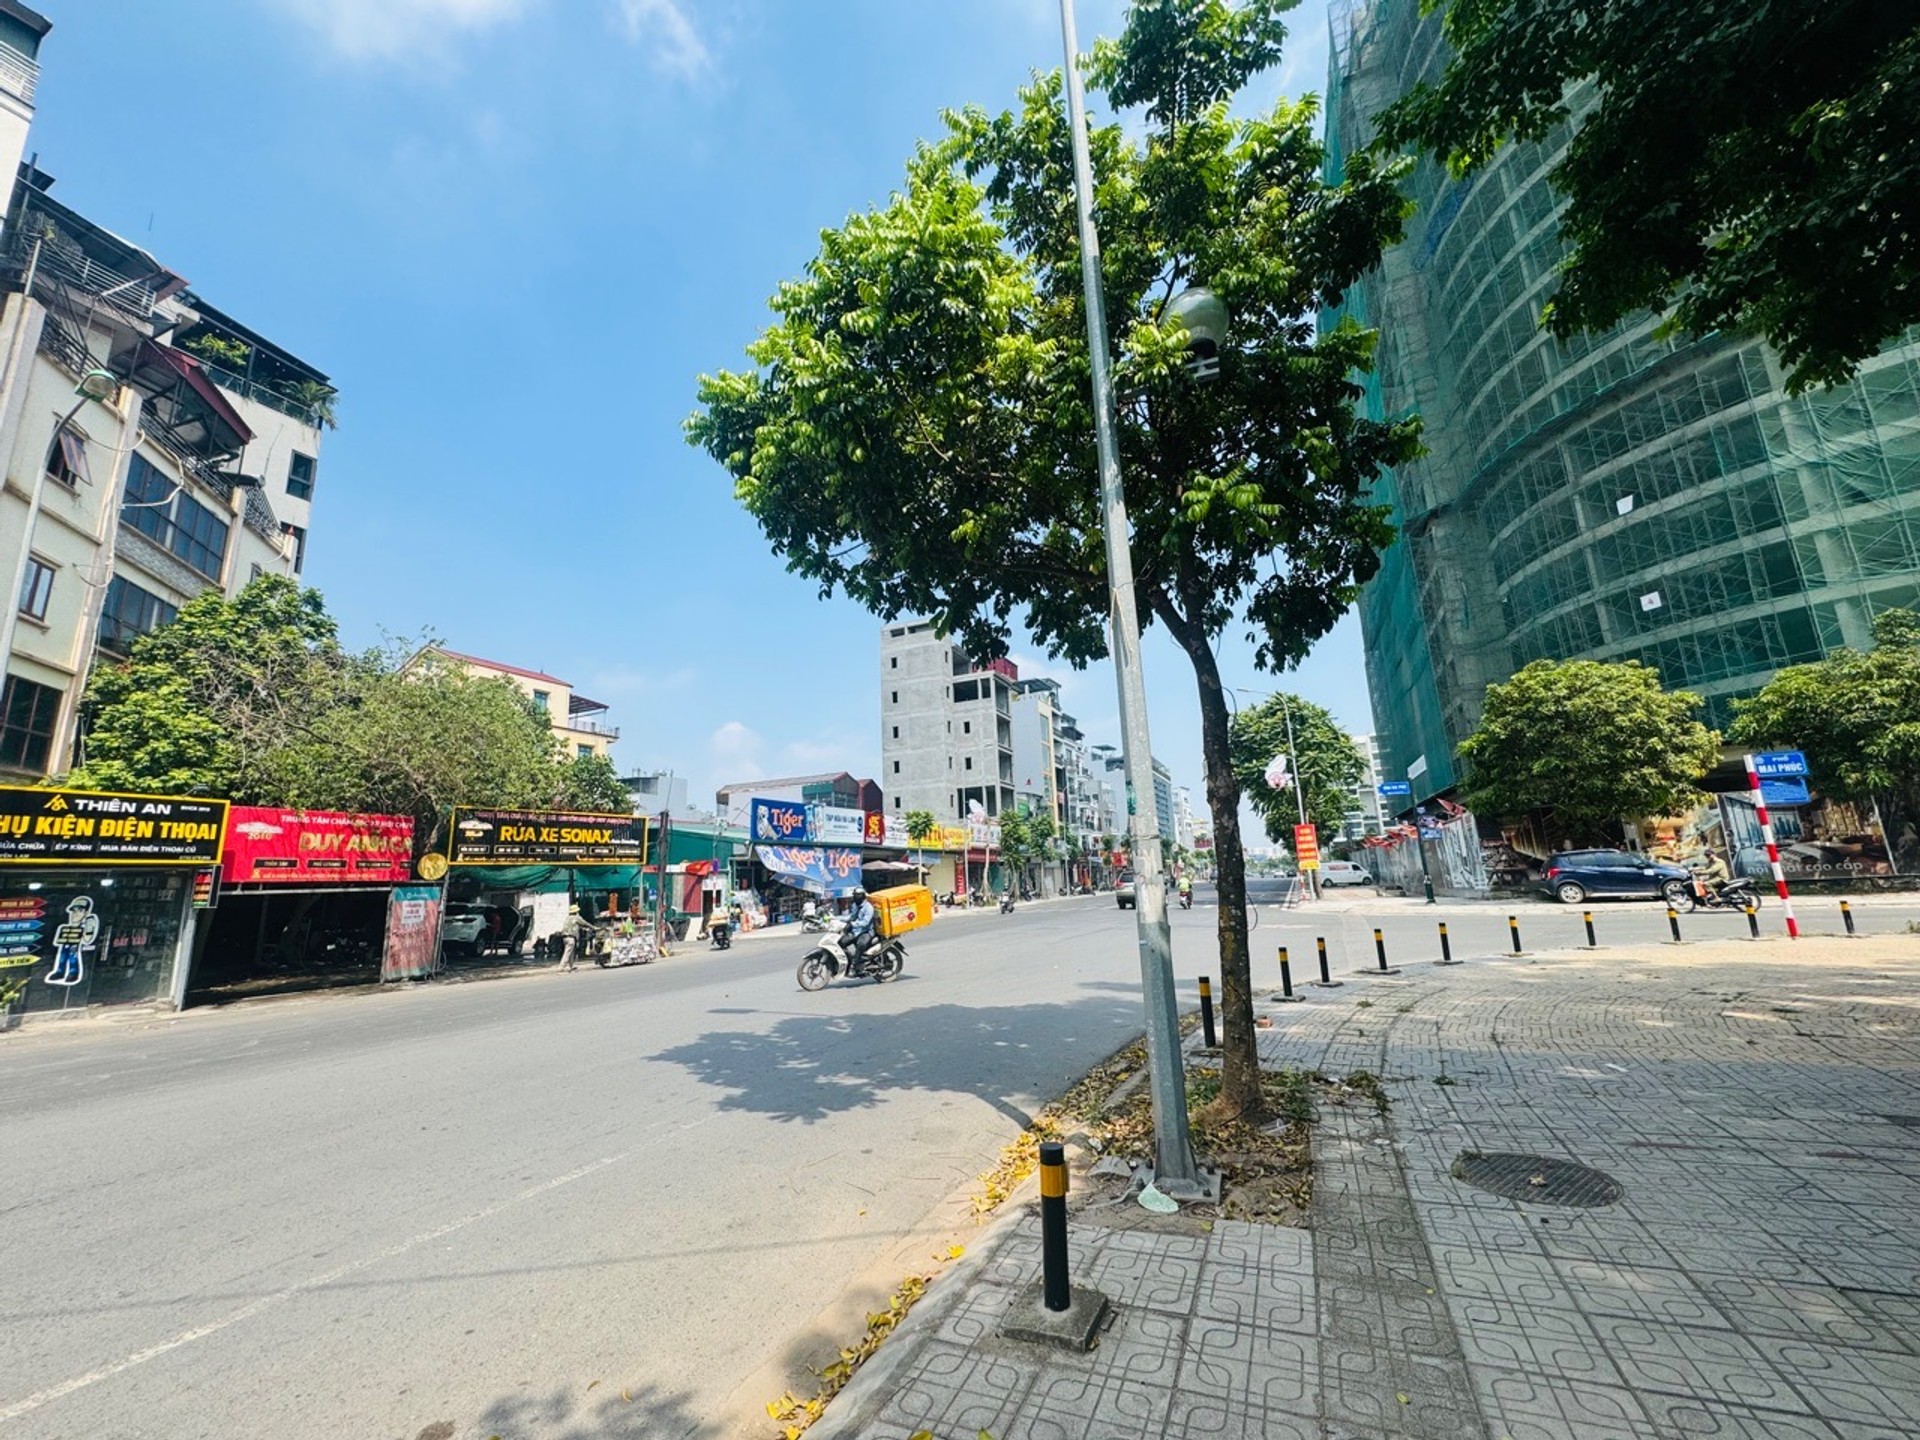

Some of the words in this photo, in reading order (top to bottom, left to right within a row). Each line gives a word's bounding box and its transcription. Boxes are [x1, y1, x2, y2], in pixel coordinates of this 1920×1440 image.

[1757, 764, 1777, 774] MAI
[1777, 761, 1803, 773] PHÚC
[74, 798, 137, 813] THIÊN
[141, 803, 172, 815] AN
[34, 813, 95, 839] KIỆN
[99, 816, 154, 841] ĐIỆN
[770, 807, 804, 835] Tiger
[299, 832, 344, 851] DUY
[538, 826, 559, 843] XE
[560, 827, 613, 844] SONAX
[773, 846, 817, 872] Tiger
[827, 848, 861, 877] Tiger
[1805, 862, 1832, 870] cao
[1836, 856, 1863, 872] cấp
